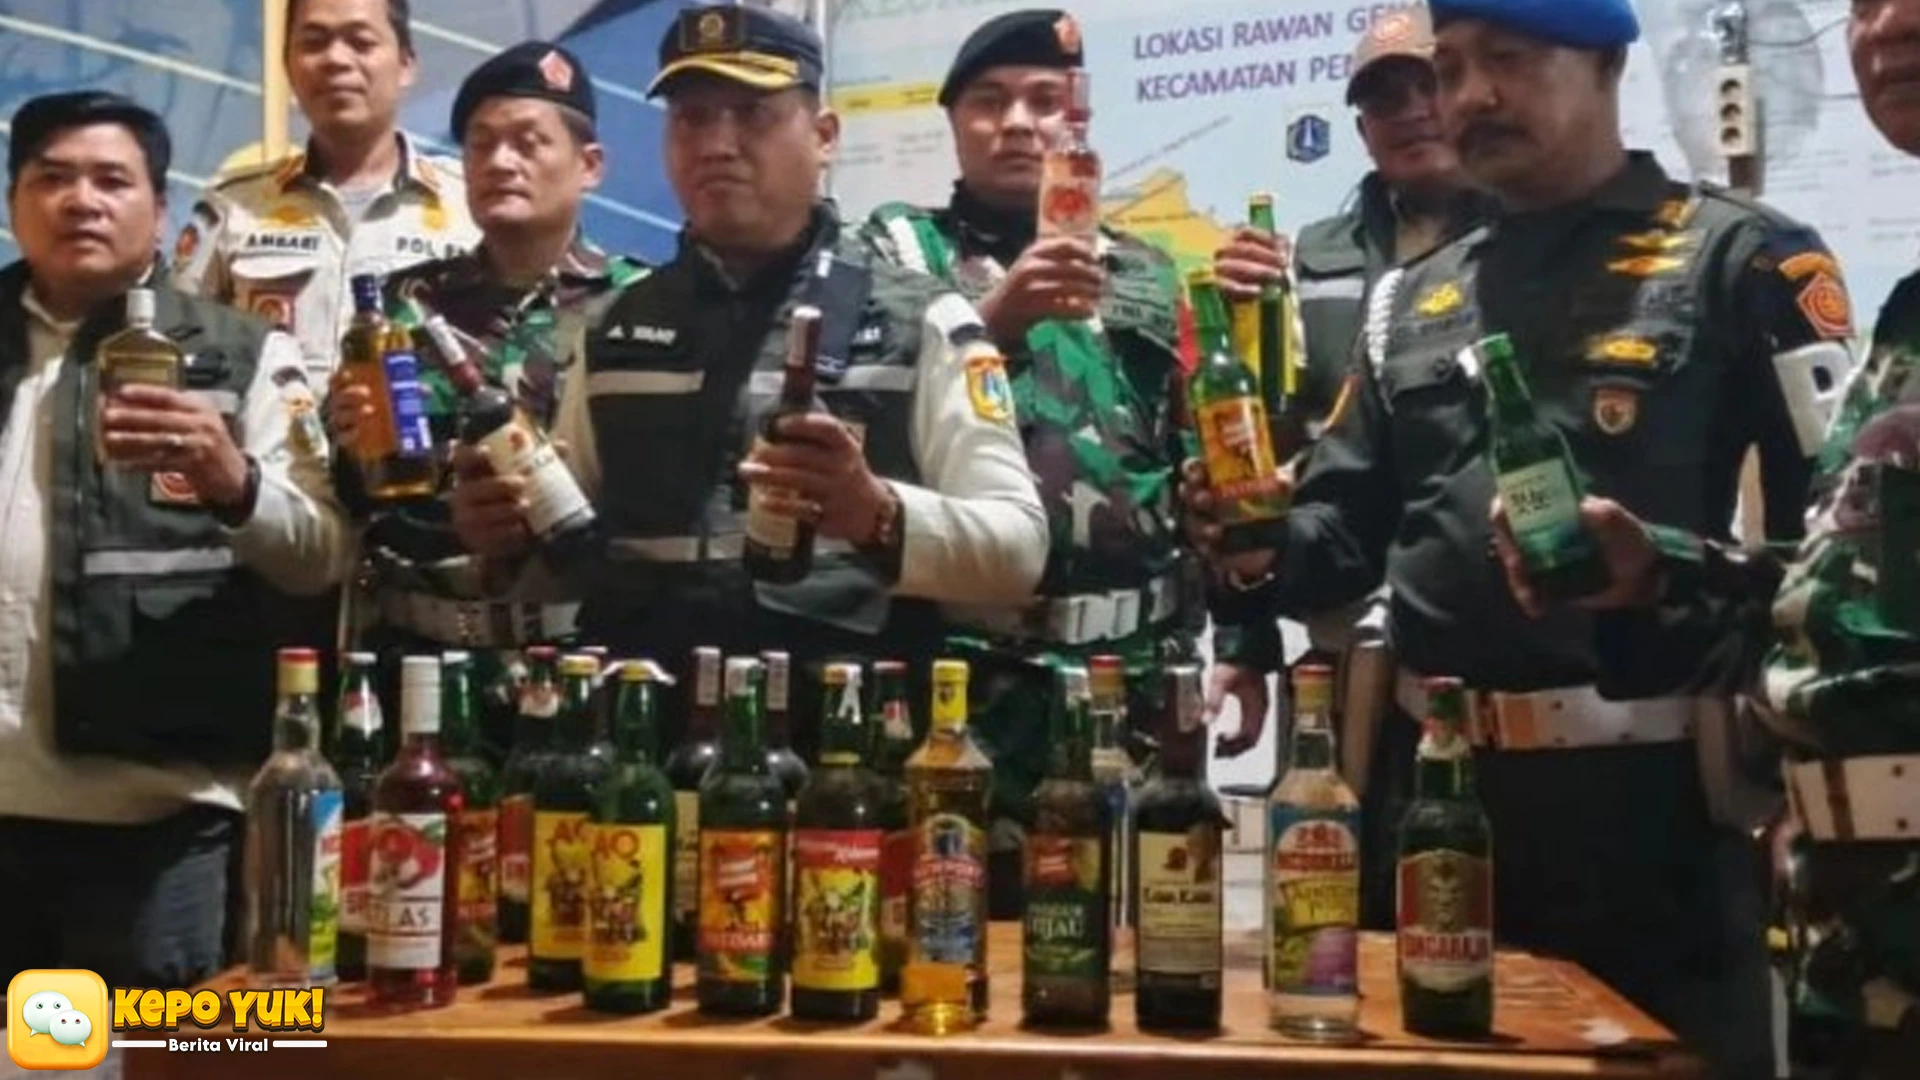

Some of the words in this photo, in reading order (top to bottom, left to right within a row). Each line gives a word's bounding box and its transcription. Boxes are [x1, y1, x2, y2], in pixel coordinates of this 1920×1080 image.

[1133, 26, 1223, 60] LOKASI
[1233, 11, 1333, 48] RAWAN
[1136, 60, 1297, 102] KECAMATAN
